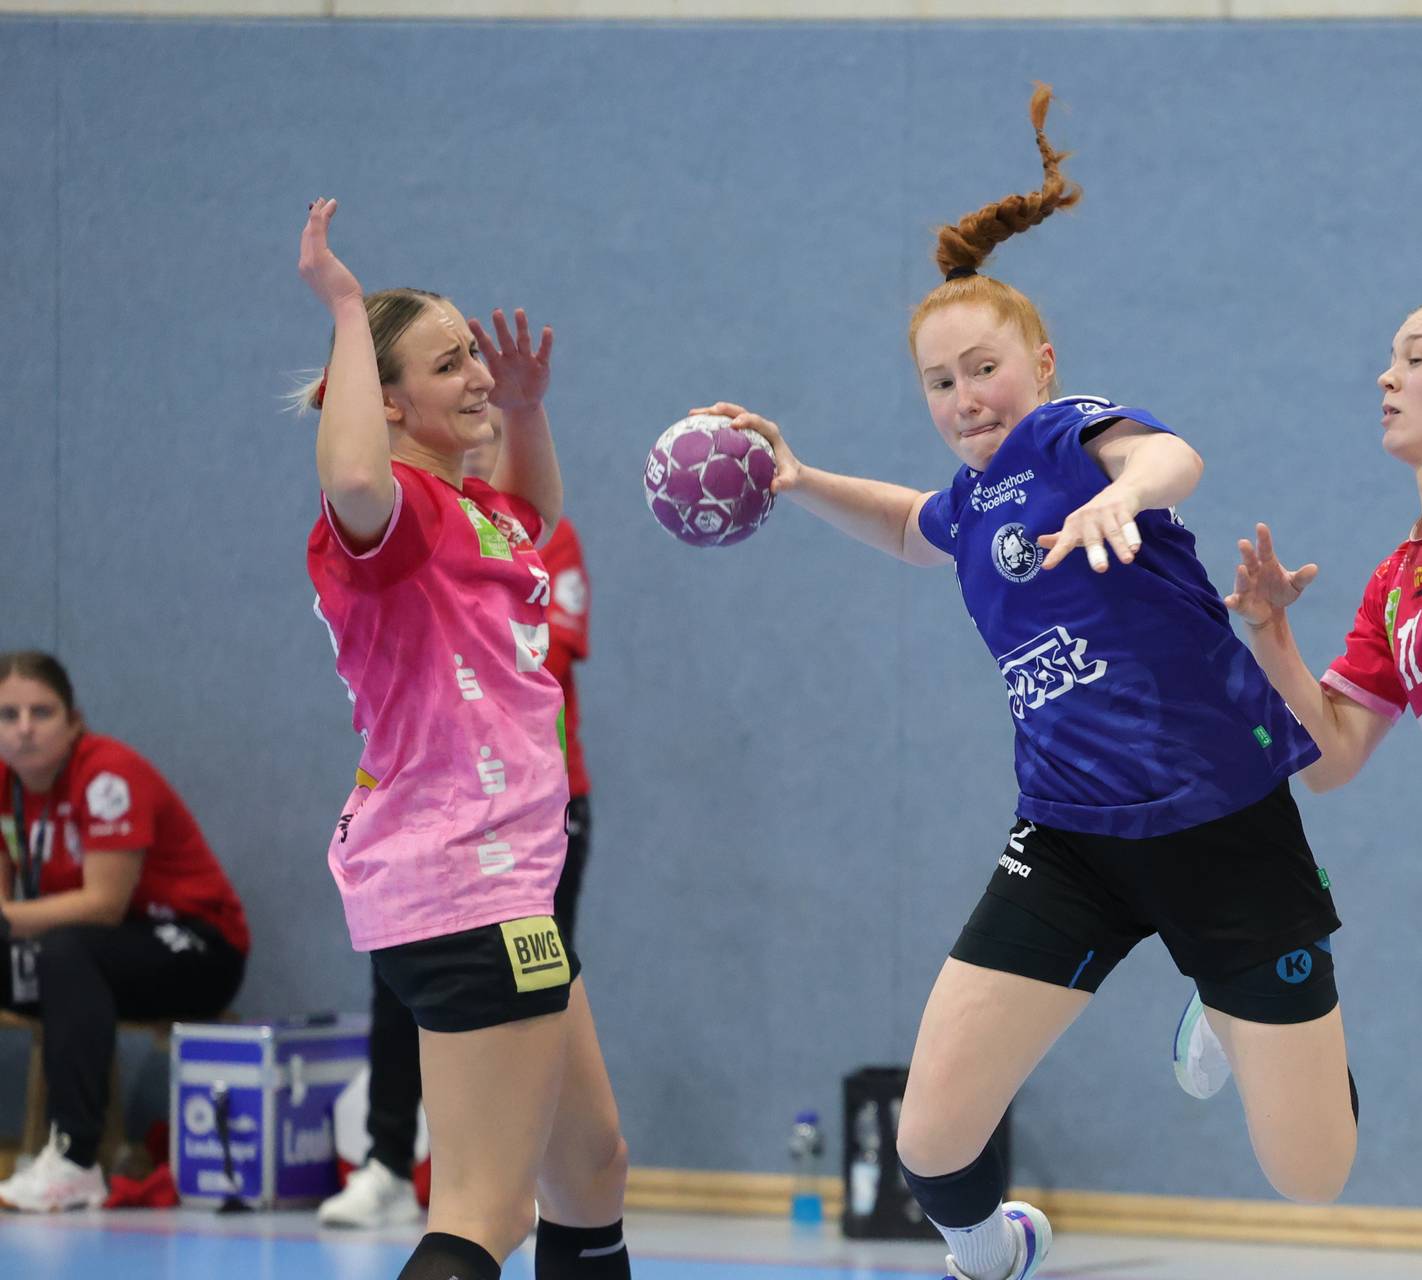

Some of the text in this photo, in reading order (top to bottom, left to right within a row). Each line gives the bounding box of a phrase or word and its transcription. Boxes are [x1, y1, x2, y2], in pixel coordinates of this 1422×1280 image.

[982, 469, 1034, 499] druckhaus
[981, 488, 1018, 513] boeken
[998, 853, 1033, 878] empa
[513, 929, 560, 965] BWG
